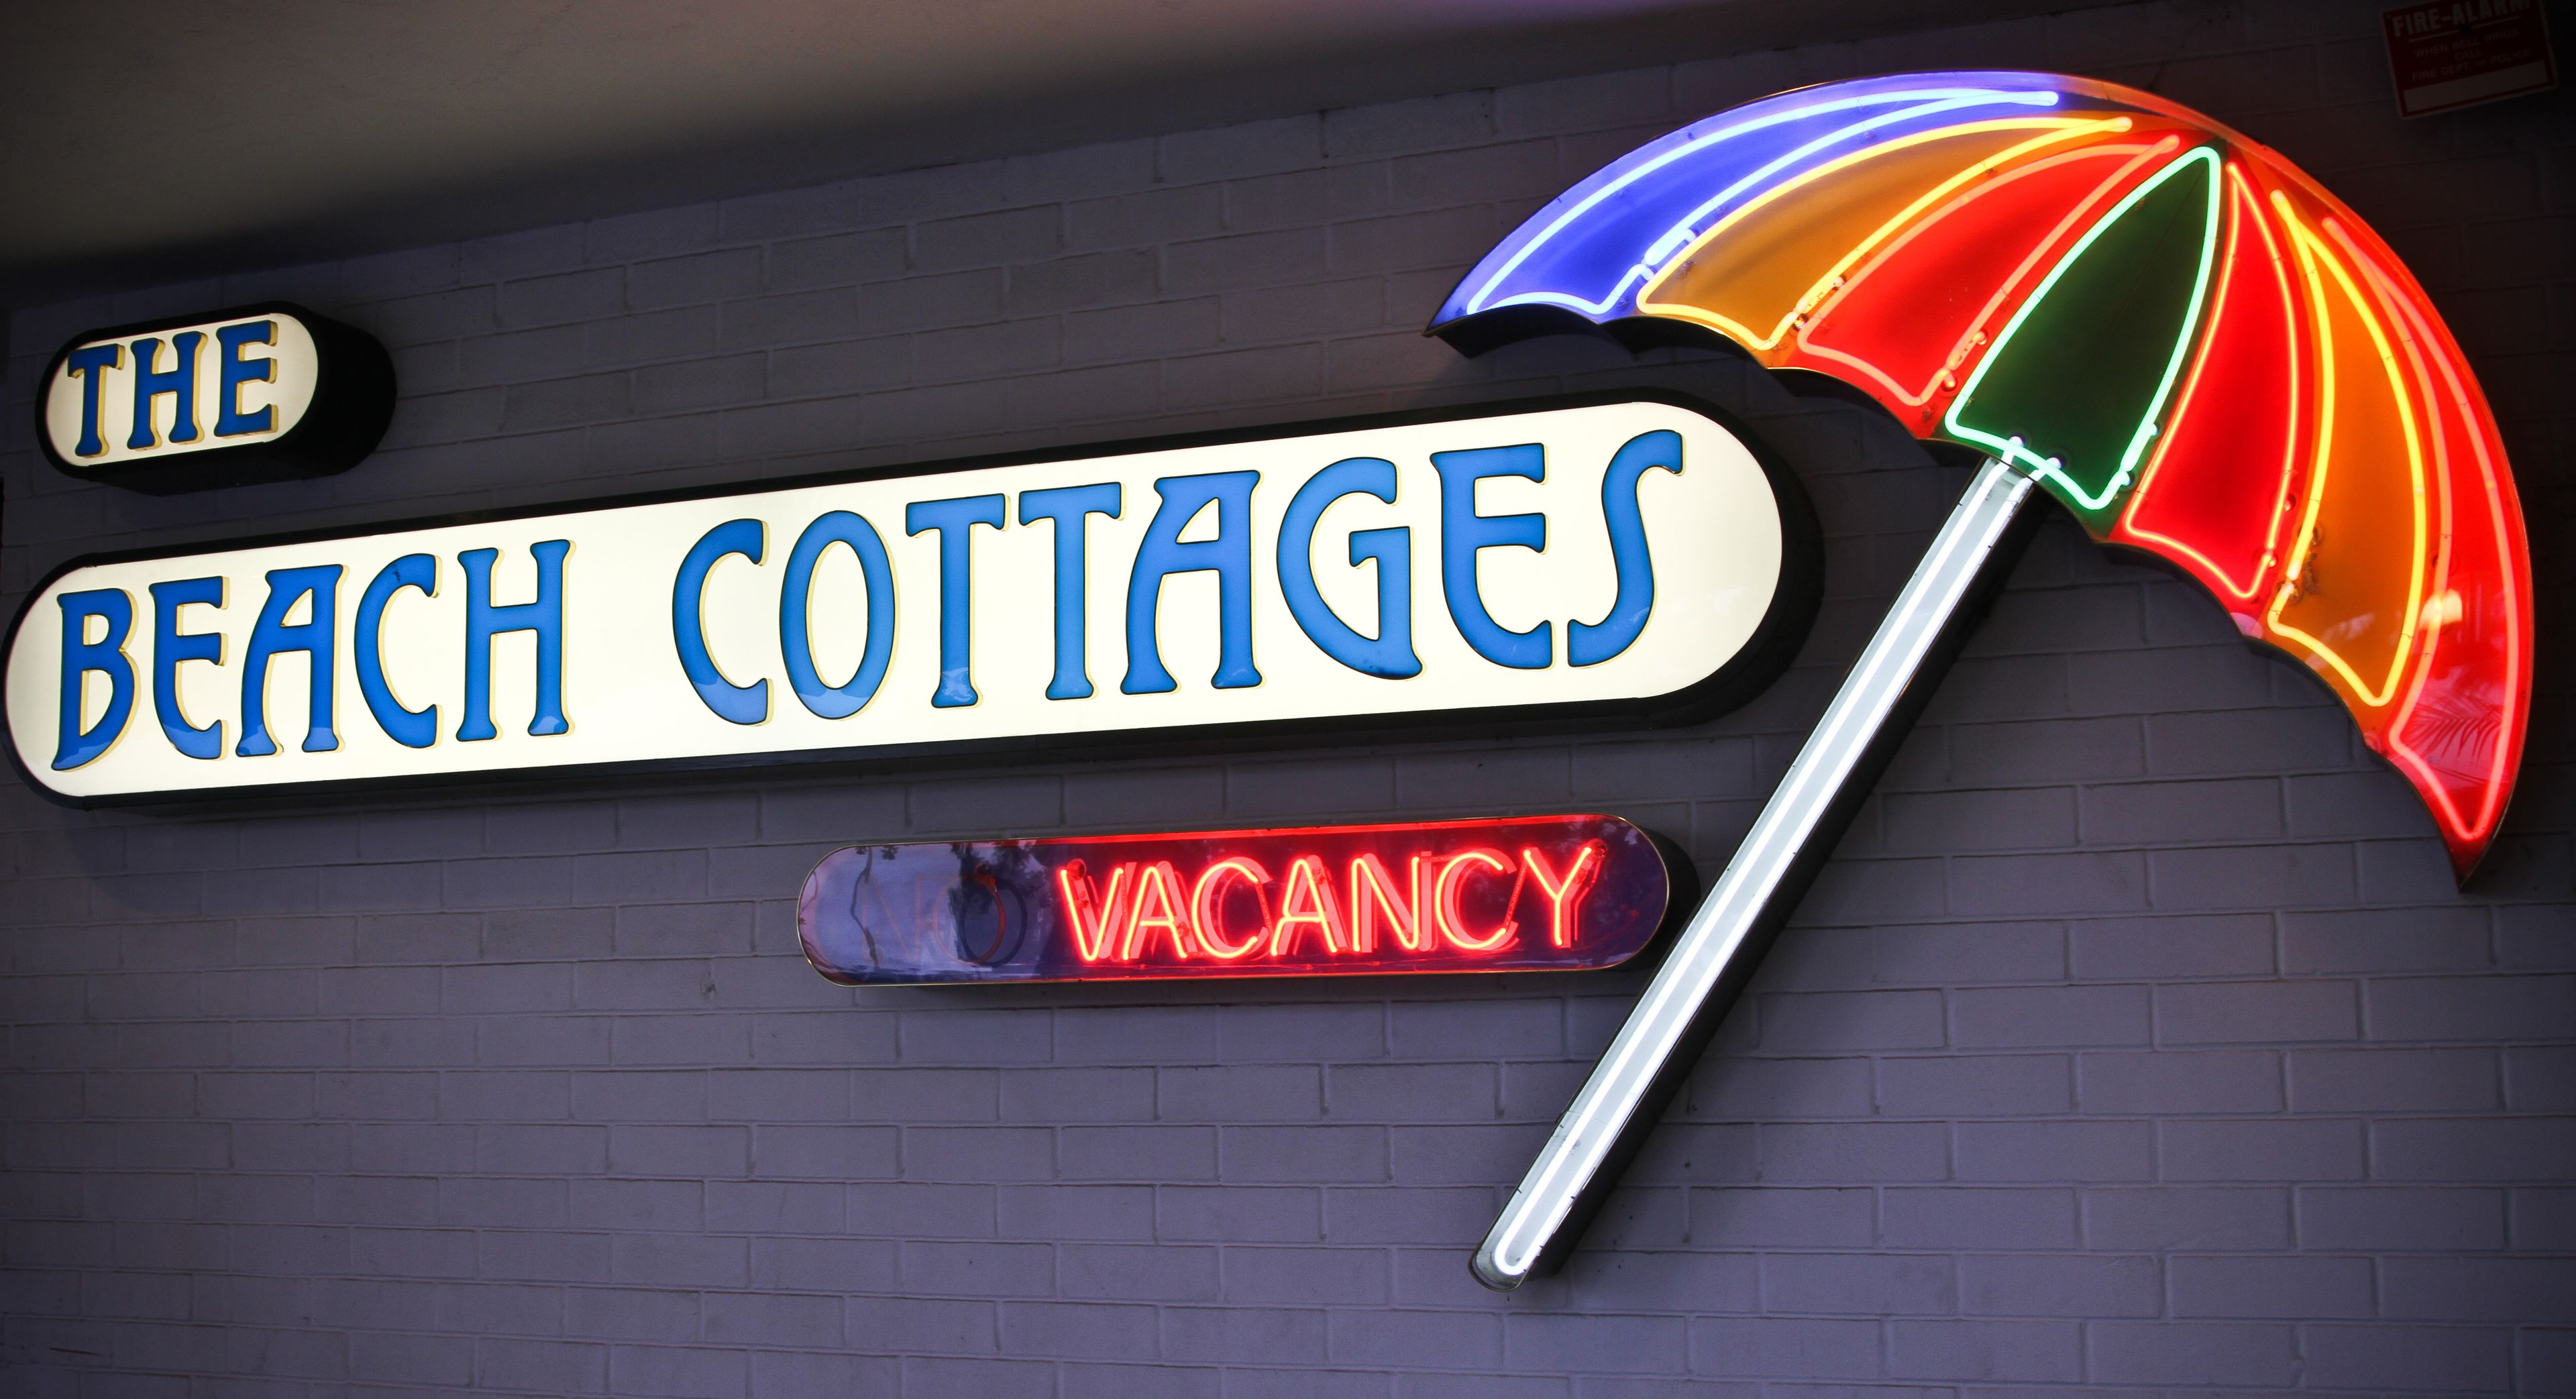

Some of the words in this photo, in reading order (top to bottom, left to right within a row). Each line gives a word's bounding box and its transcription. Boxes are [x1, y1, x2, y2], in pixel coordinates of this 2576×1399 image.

[2412, 70, 2437, 81] FIRE
[2491, 48, 2532, 65] POLICE
[2414, 44, 2449, 58] WHEN
[2452, 38, 2480, 50] BELL
[2484, 28, 2520, 43] RINGS
[2455, 48, 2483, 60] CALL
[68, 320, 277, 457] THE
[50, 539, 576, 772] BEACH
[672, 429, 1684, 726] COTTAGES
[1058, 845, 1607, 962] VACANCY
